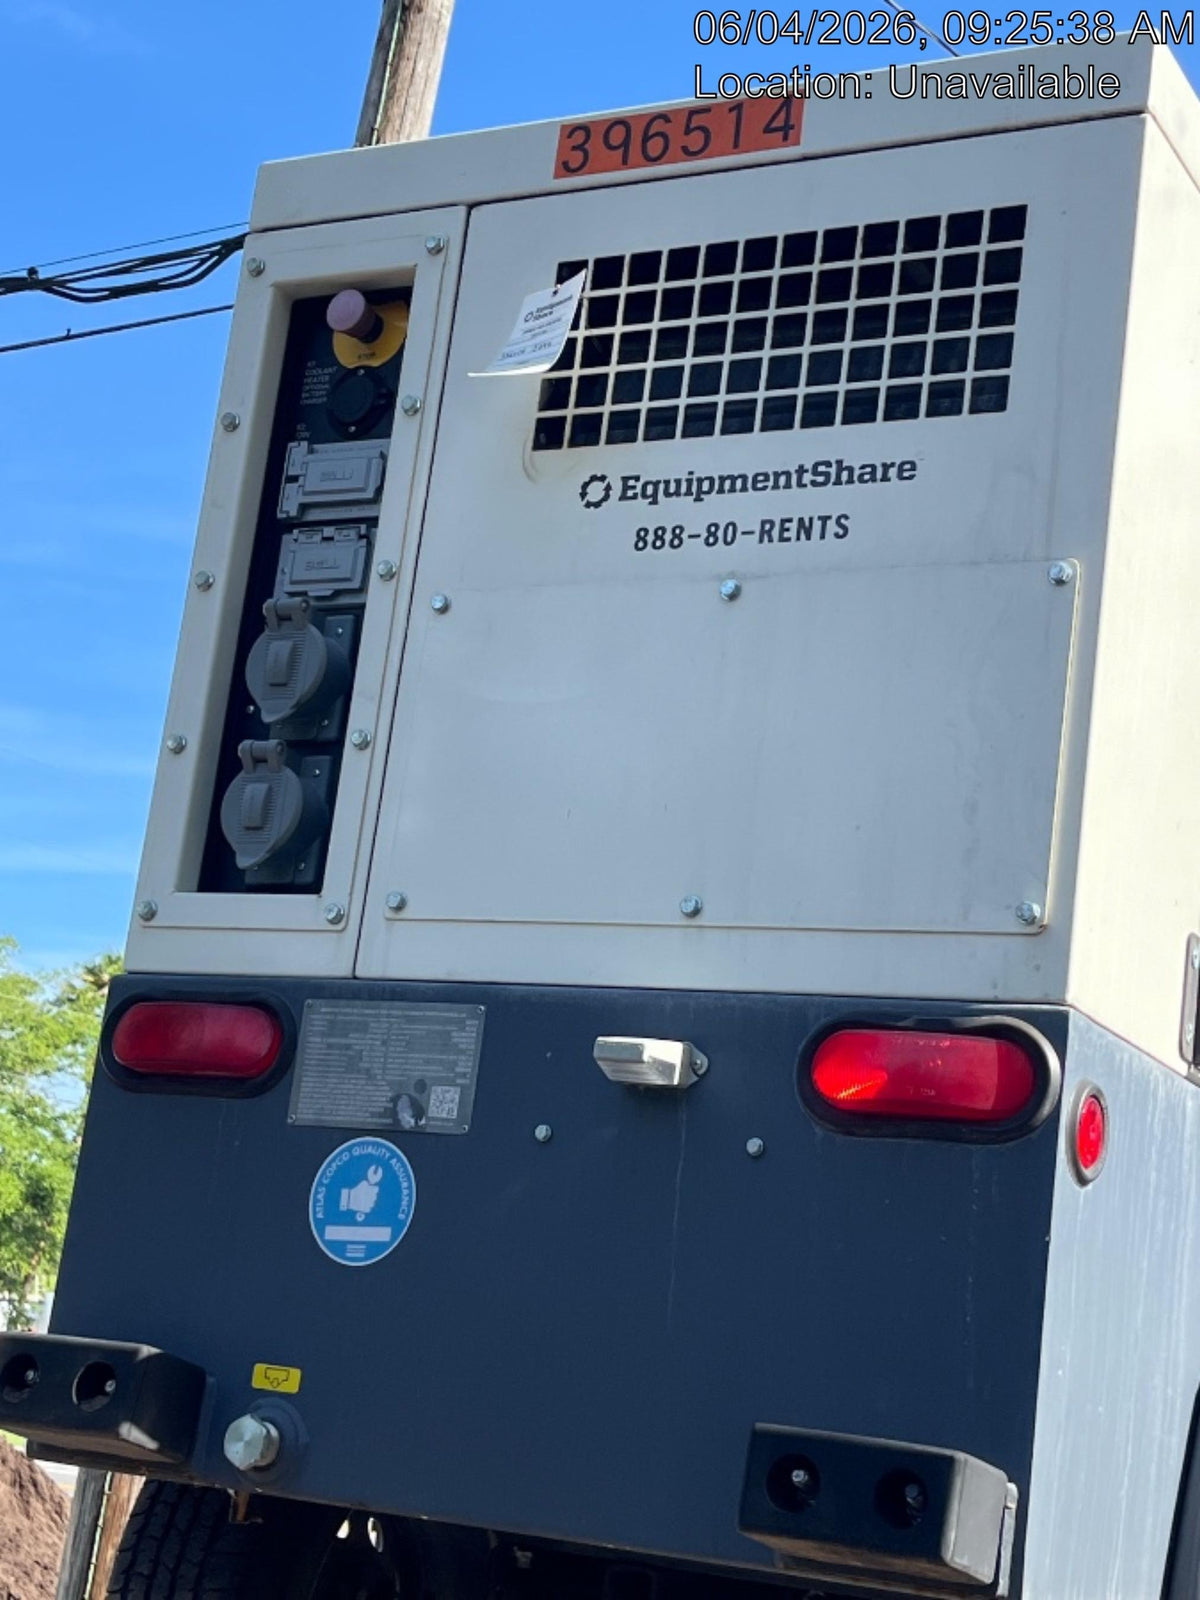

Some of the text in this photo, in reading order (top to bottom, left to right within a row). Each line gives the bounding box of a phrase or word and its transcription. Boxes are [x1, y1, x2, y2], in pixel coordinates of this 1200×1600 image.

[561, 95, 796, 174] 396514
[618, 459, 917, 505] EquipmentShare
[634, 513, 851, 552] 888-80-RENTS
[351, 1145, 391, 1159] QUALITY
